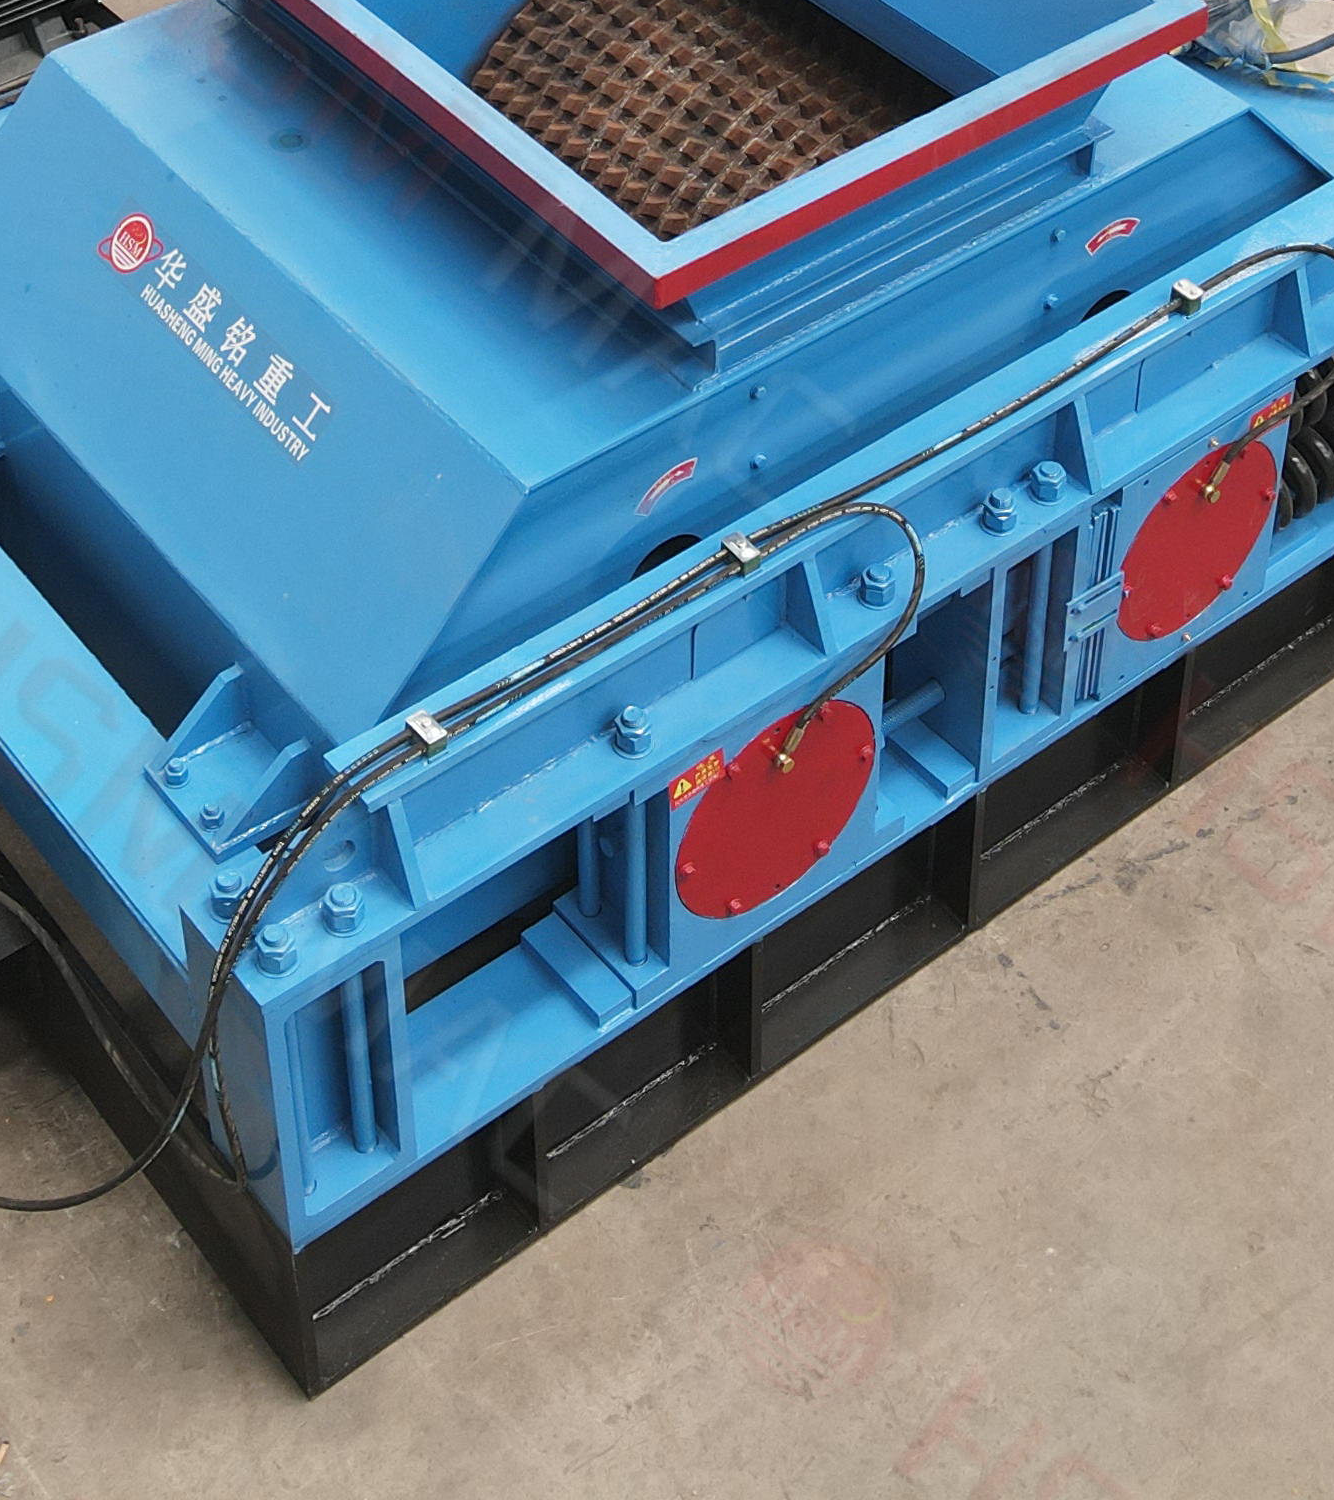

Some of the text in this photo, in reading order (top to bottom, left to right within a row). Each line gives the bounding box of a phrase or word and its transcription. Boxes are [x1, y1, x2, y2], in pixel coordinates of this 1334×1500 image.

[119, 231, 144, 258] HSM
[140, 283, 310, 461] HUASHENG MING HEAVY INDUSTRY
[154, 248, 331, 441] 华盛铭重工
